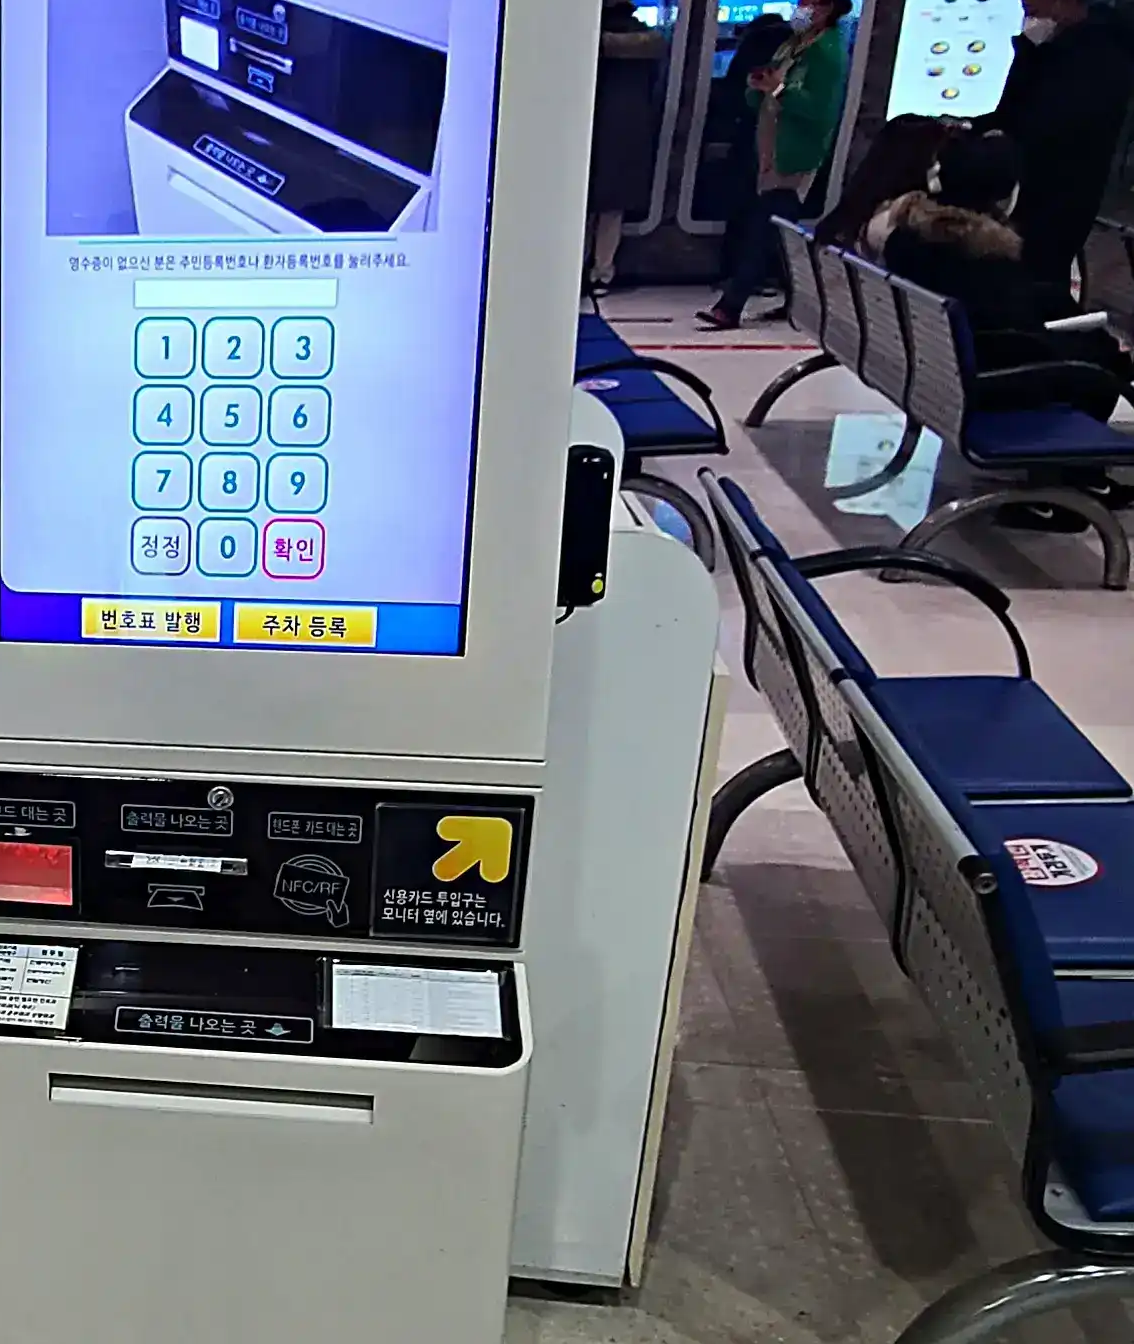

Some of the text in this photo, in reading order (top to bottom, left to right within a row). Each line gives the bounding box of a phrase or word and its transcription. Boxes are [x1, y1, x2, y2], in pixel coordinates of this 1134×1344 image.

[69, 255, 113, 272] 영수증이
[117, 255, 151, 271] 없으신
[154, 255, 176, 271] 분은
[180, 254, 259, 271] 주민등록번호나
[162, 335, 311, 360] 1 2 3
[157, 403, 308, 429] 4 5 6
[156, 469, 306, 495] 7 8 9
[141, 535, 314, 563] 정정 0 확인
[101, 610, 201, 634] 번호표 발행
[262, 615, 348, 639] 주차 등록
[21, 805, 50, 822] 대는
[52, 807, 67, 823] 곳
[126, 810, 229, 830] 출력물 나오는 곳
[305, 819, 324, 836] 카드
[326, 820, 346, 837] 대는
[347, 822, 359, 838] 곳
[282, 878, 341, 896] NFC/RF
[383, 888, 487, 908] 신용카드 투입구는
[381, 906, 506, 929] 모니터 옆에 있습니다.
[137, 1011, 257, 1036] 출력물 나오는 곳
